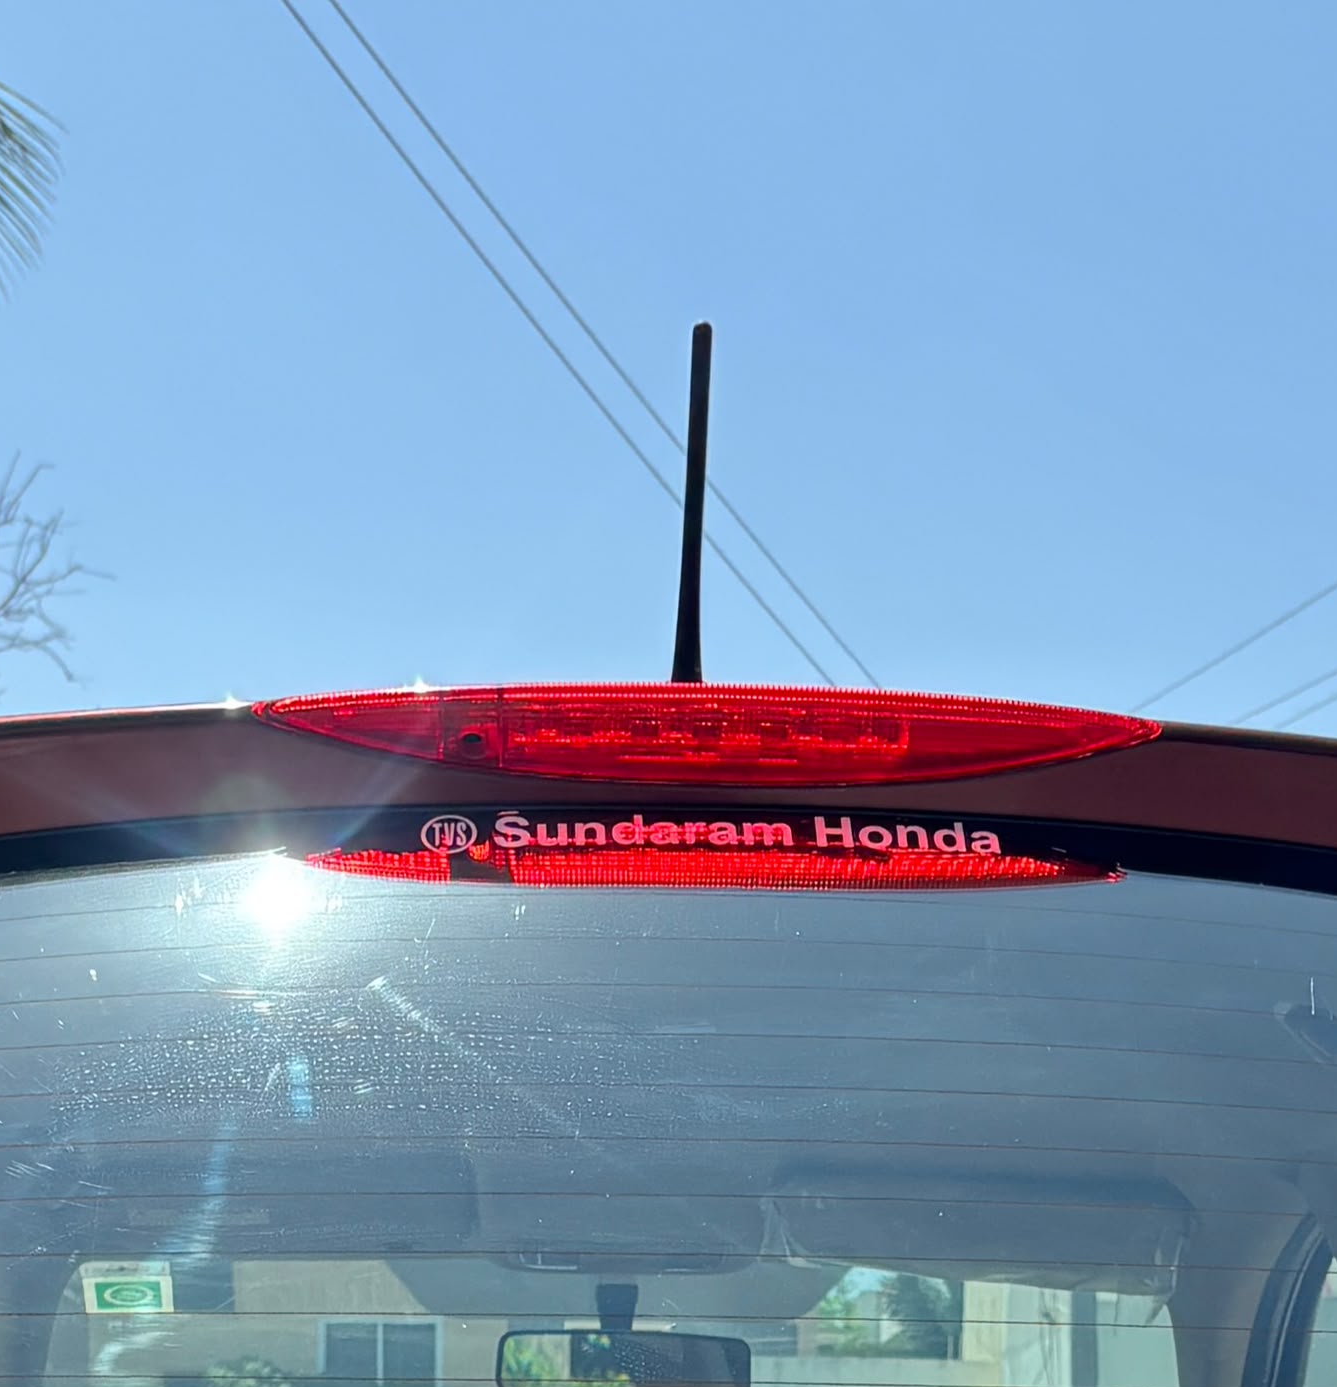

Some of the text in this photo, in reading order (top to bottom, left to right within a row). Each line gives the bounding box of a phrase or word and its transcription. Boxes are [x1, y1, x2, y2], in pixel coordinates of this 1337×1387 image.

[432, 814, 1002, 854] TVS Sundaram Honda
